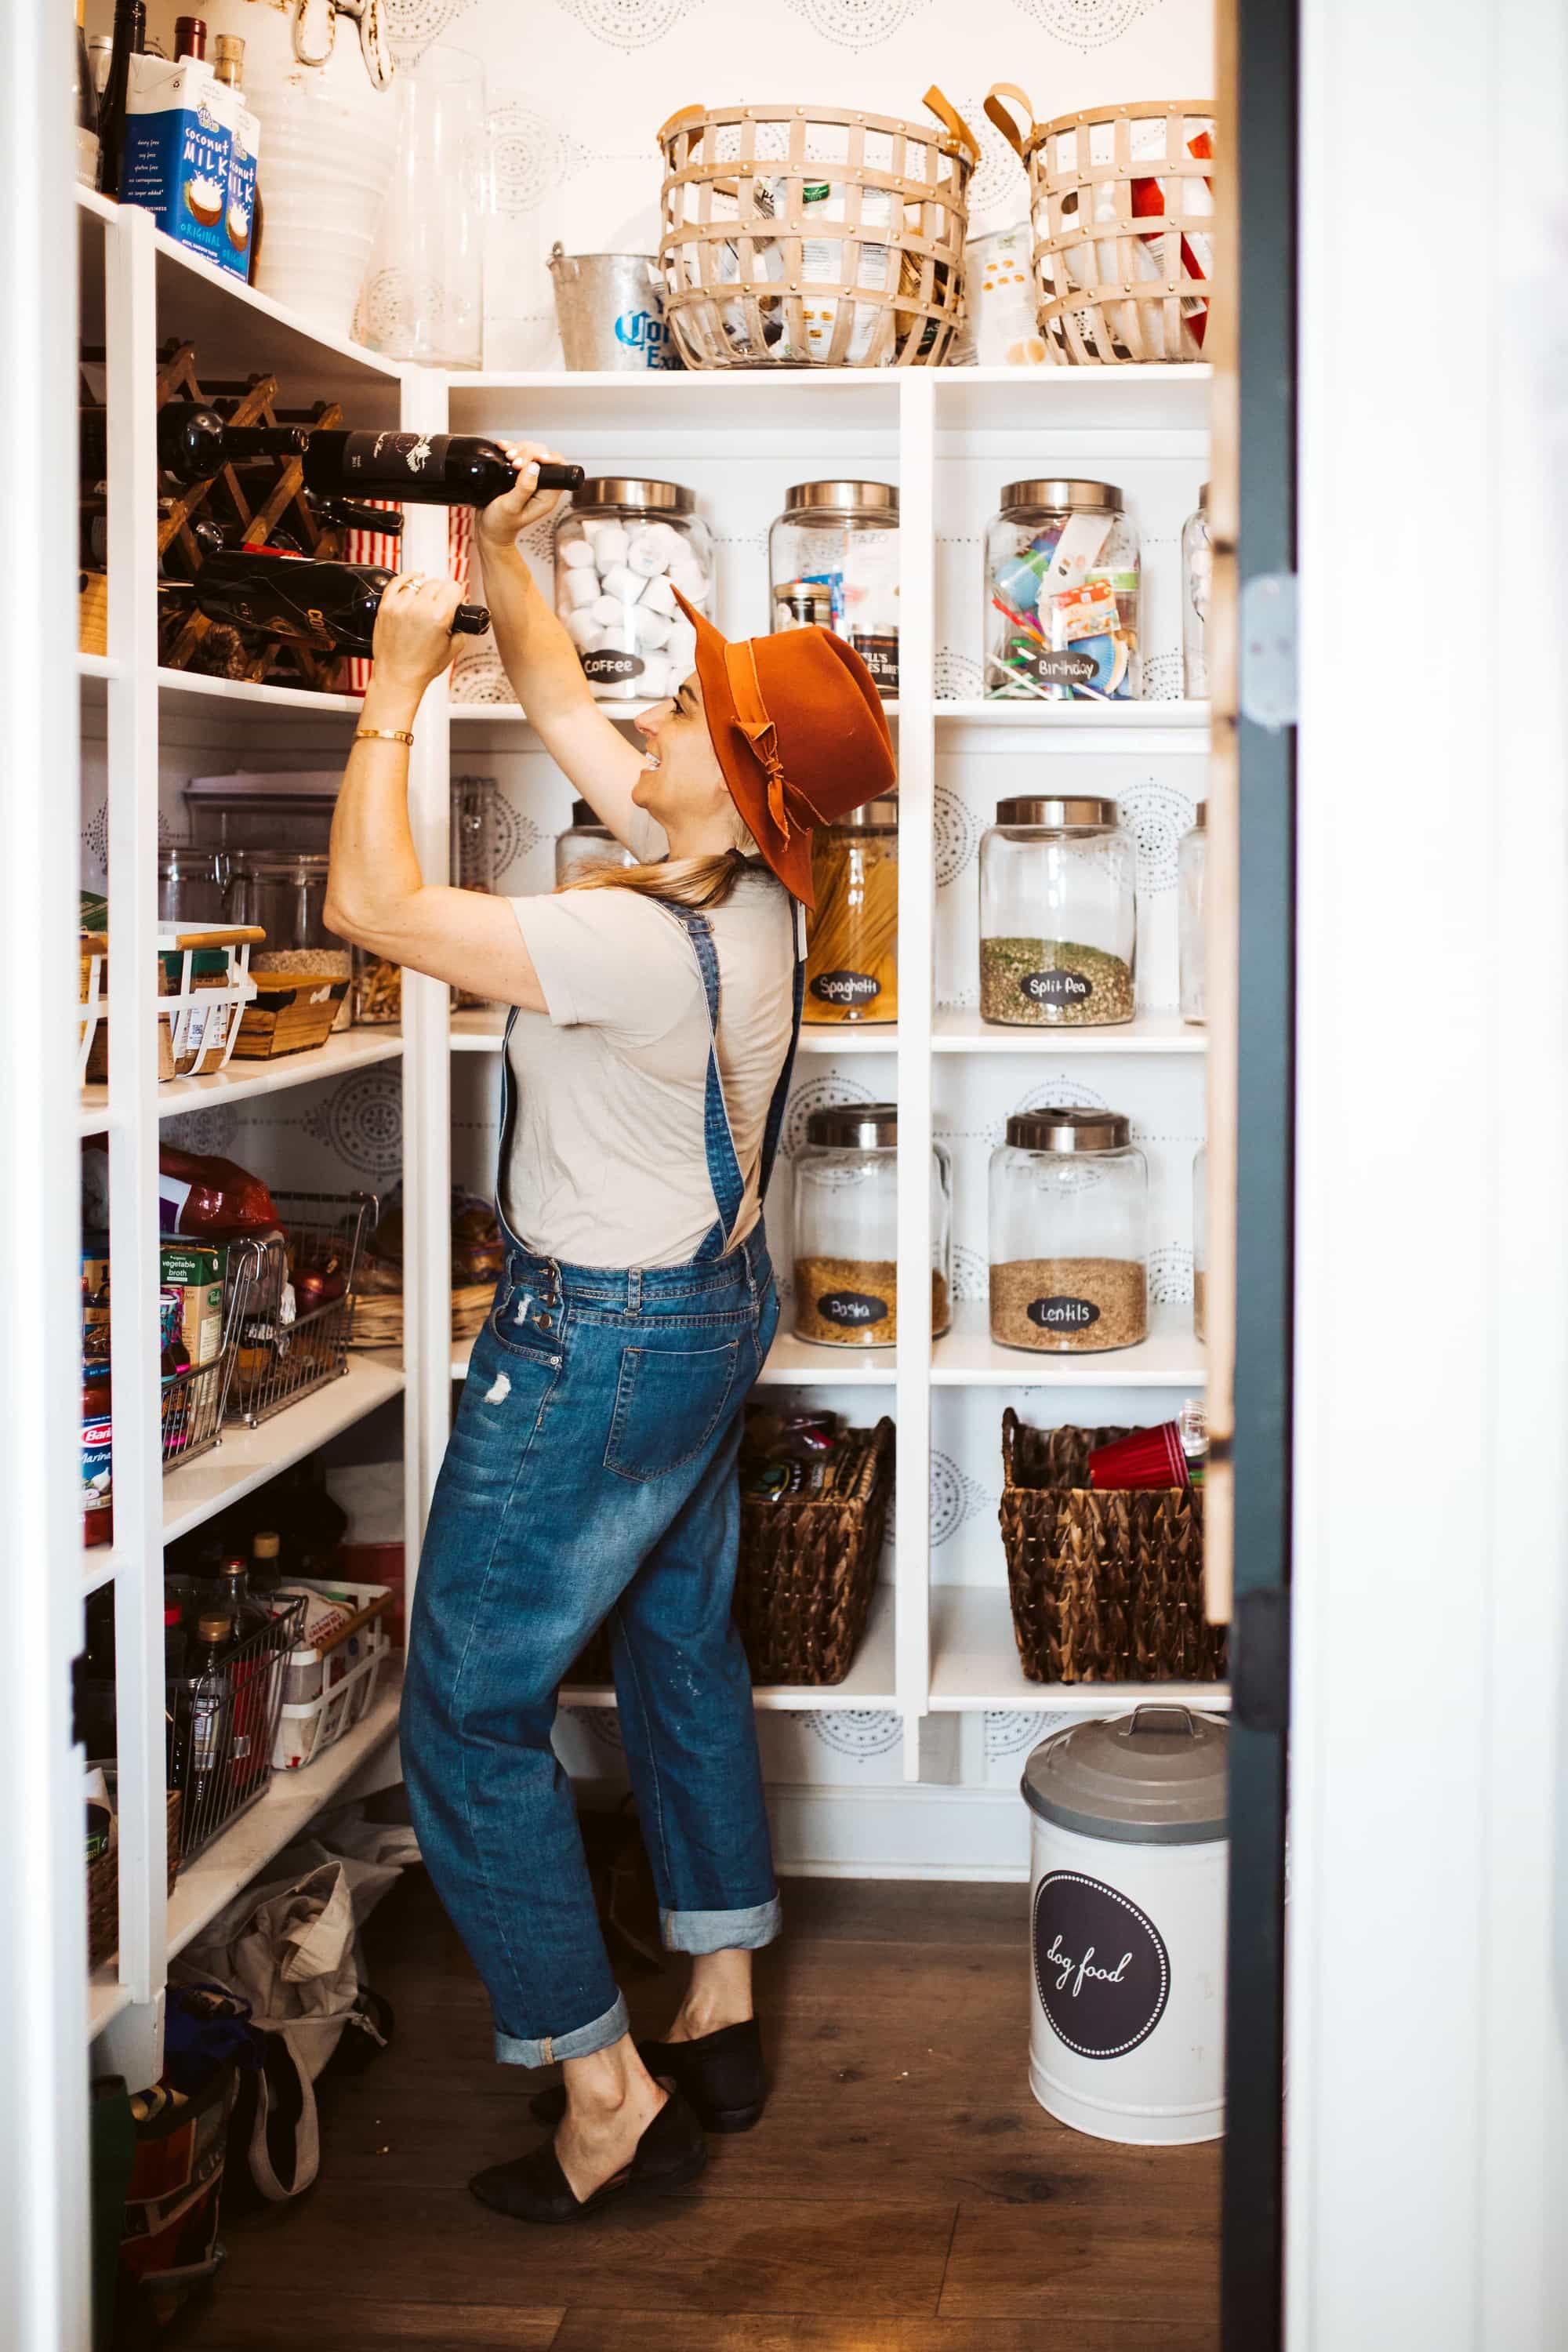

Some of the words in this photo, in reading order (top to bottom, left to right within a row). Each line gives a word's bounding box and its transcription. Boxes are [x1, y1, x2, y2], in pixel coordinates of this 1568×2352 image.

[185, 127, 229, 155] coconut
[183, 141, 228, 176] MILK
[180, 223, 220, 248] ORIGINAL
[1038, 659, 1094, 680] Birthday
[820, 975, 877, 1001] Spaghetti
[1030, 978, 1062, 998] Split
[1065, 976, 1086, 994] Pea
[162, 1258, 196, 1269] vegetable
[168, 1268, 187, 1278] broth
[831, 1300, 870, 1318] Pasta
[1041, 1304, 1090, 1321] Lentils
[84, 1428, 112, 1443] Bari
[1047, 1934, 1076, 1990] dog
[1072, 1947, 1134, 1998] food
